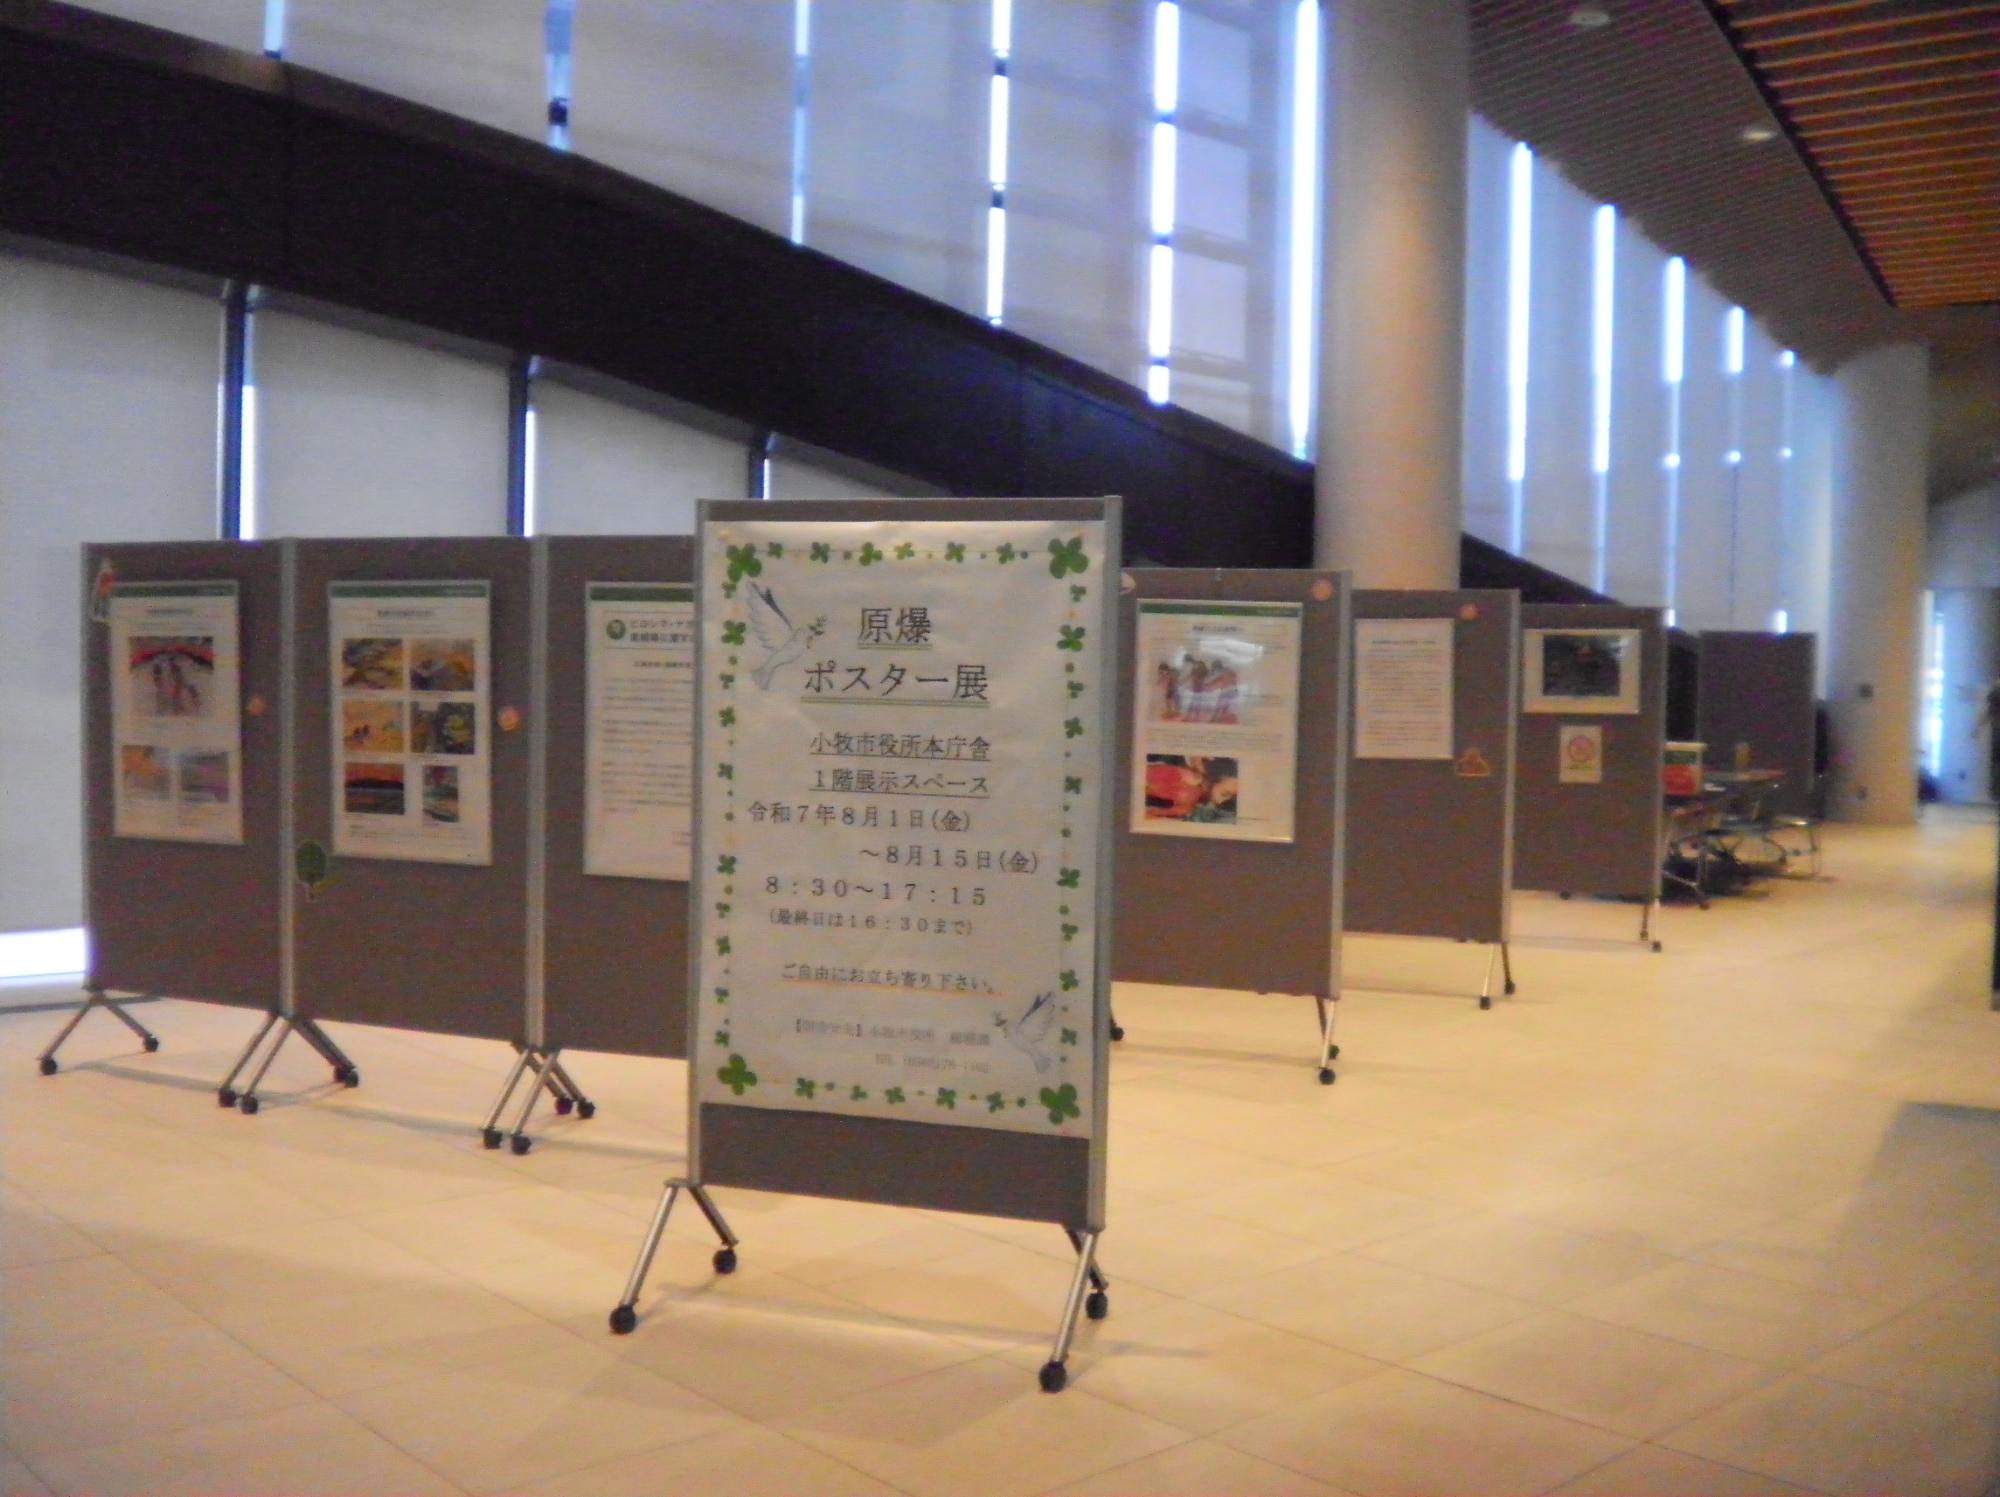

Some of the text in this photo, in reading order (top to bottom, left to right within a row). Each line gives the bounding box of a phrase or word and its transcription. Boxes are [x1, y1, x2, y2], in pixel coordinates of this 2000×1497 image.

[857, 607, 933, 643] 原爆
[804, 660, 990, 701] ポスター展
[811, 732, 992, 759] 小牧市役所本庁舎
